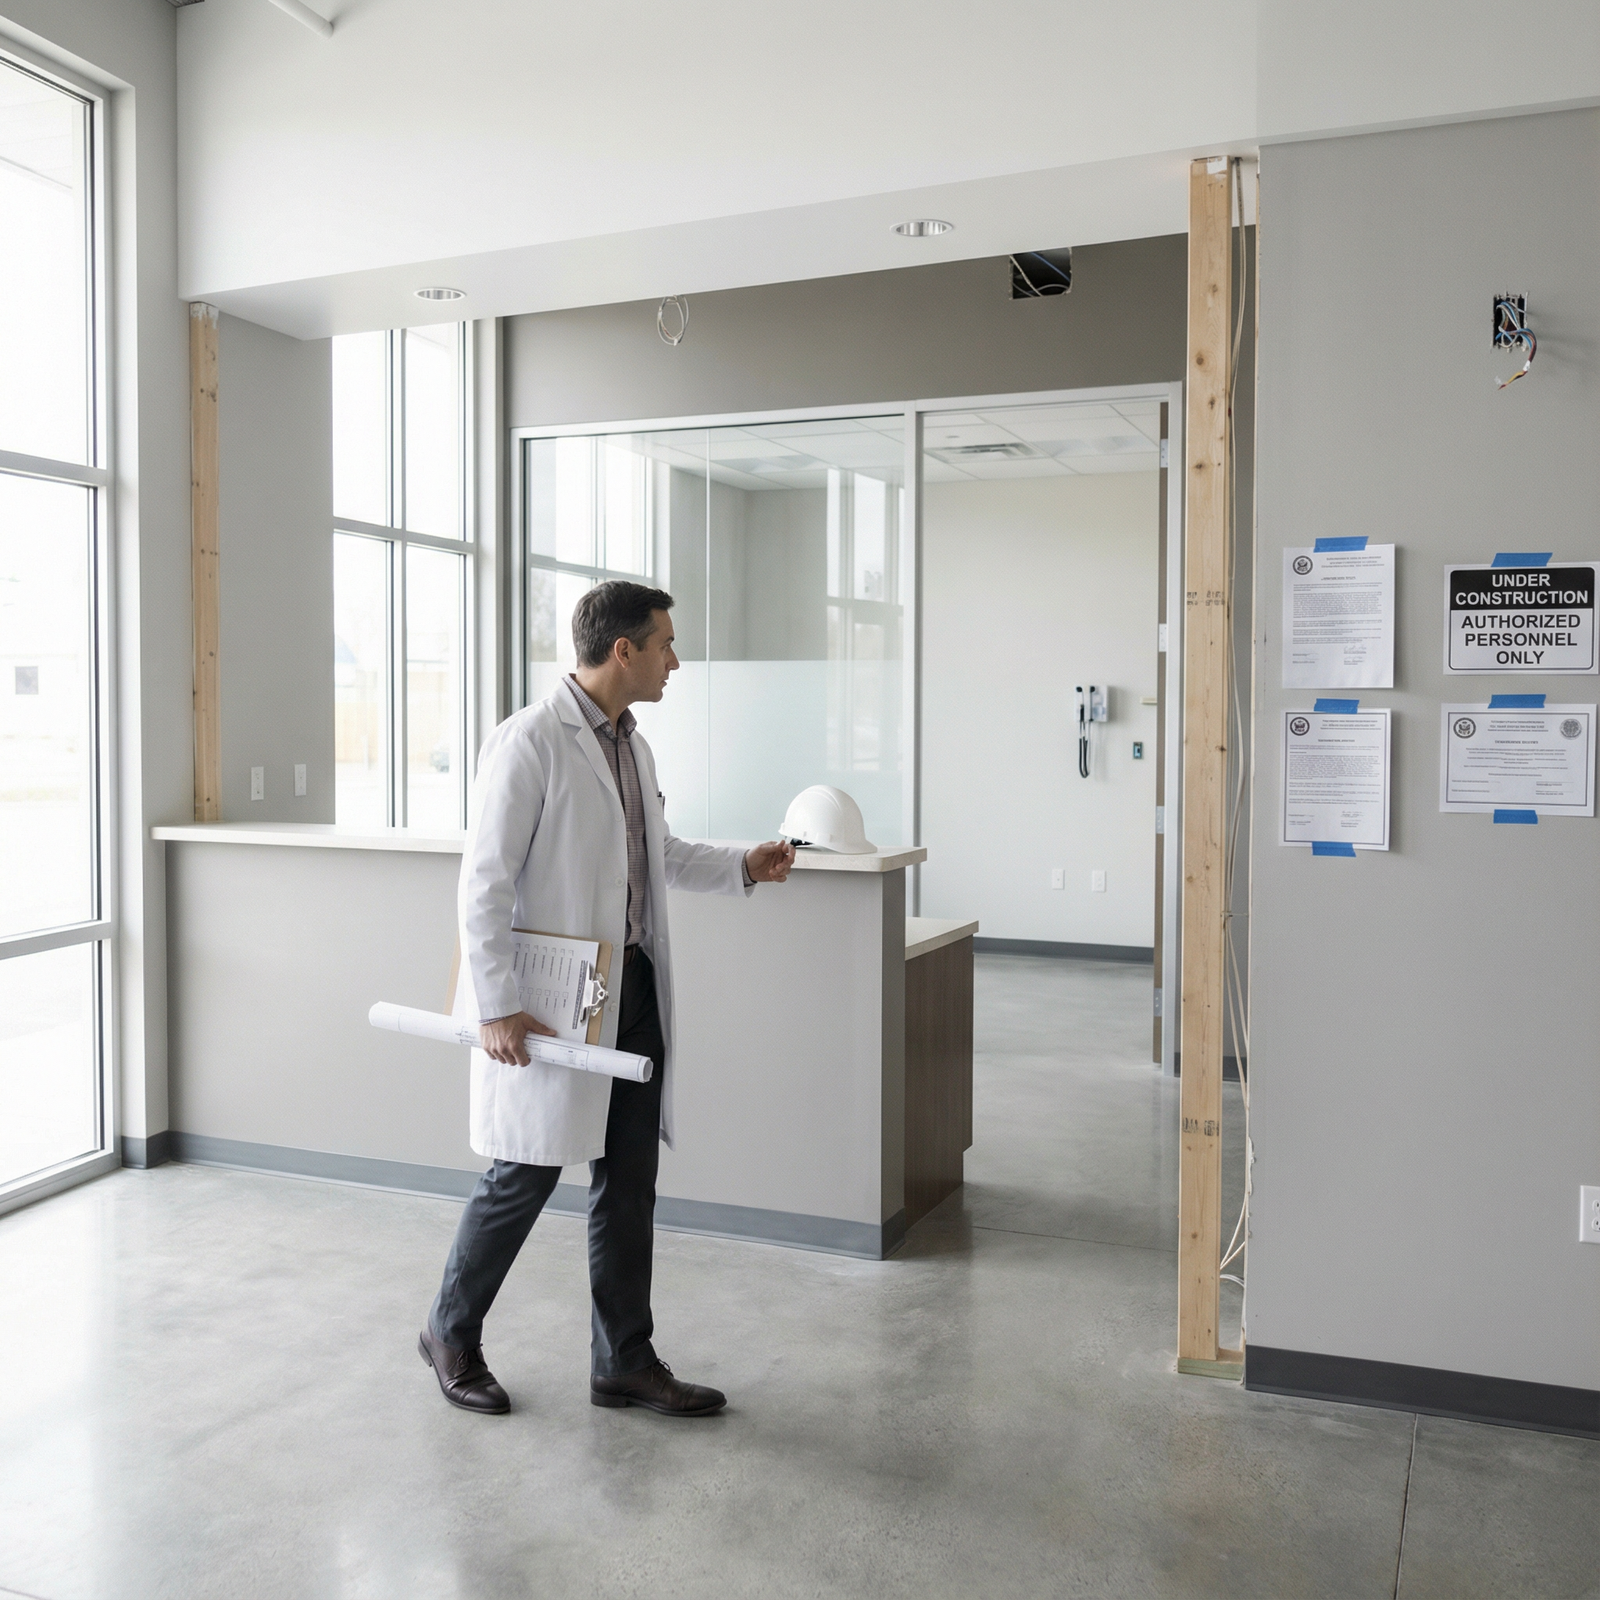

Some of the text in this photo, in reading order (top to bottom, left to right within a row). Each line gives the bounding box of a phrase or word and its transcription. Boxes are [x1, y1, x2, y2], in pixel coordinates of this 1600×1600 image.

[1491, 574, 1551, 587] UNDER
[1455, 590, 1588, 605] CONSTRUCTION
[1461, 614, 1581, 629] AUTHORIZED
[1465, 632, 1578, 647] PERSONNEL
[1496, 650, 1545, 665] ONLY
